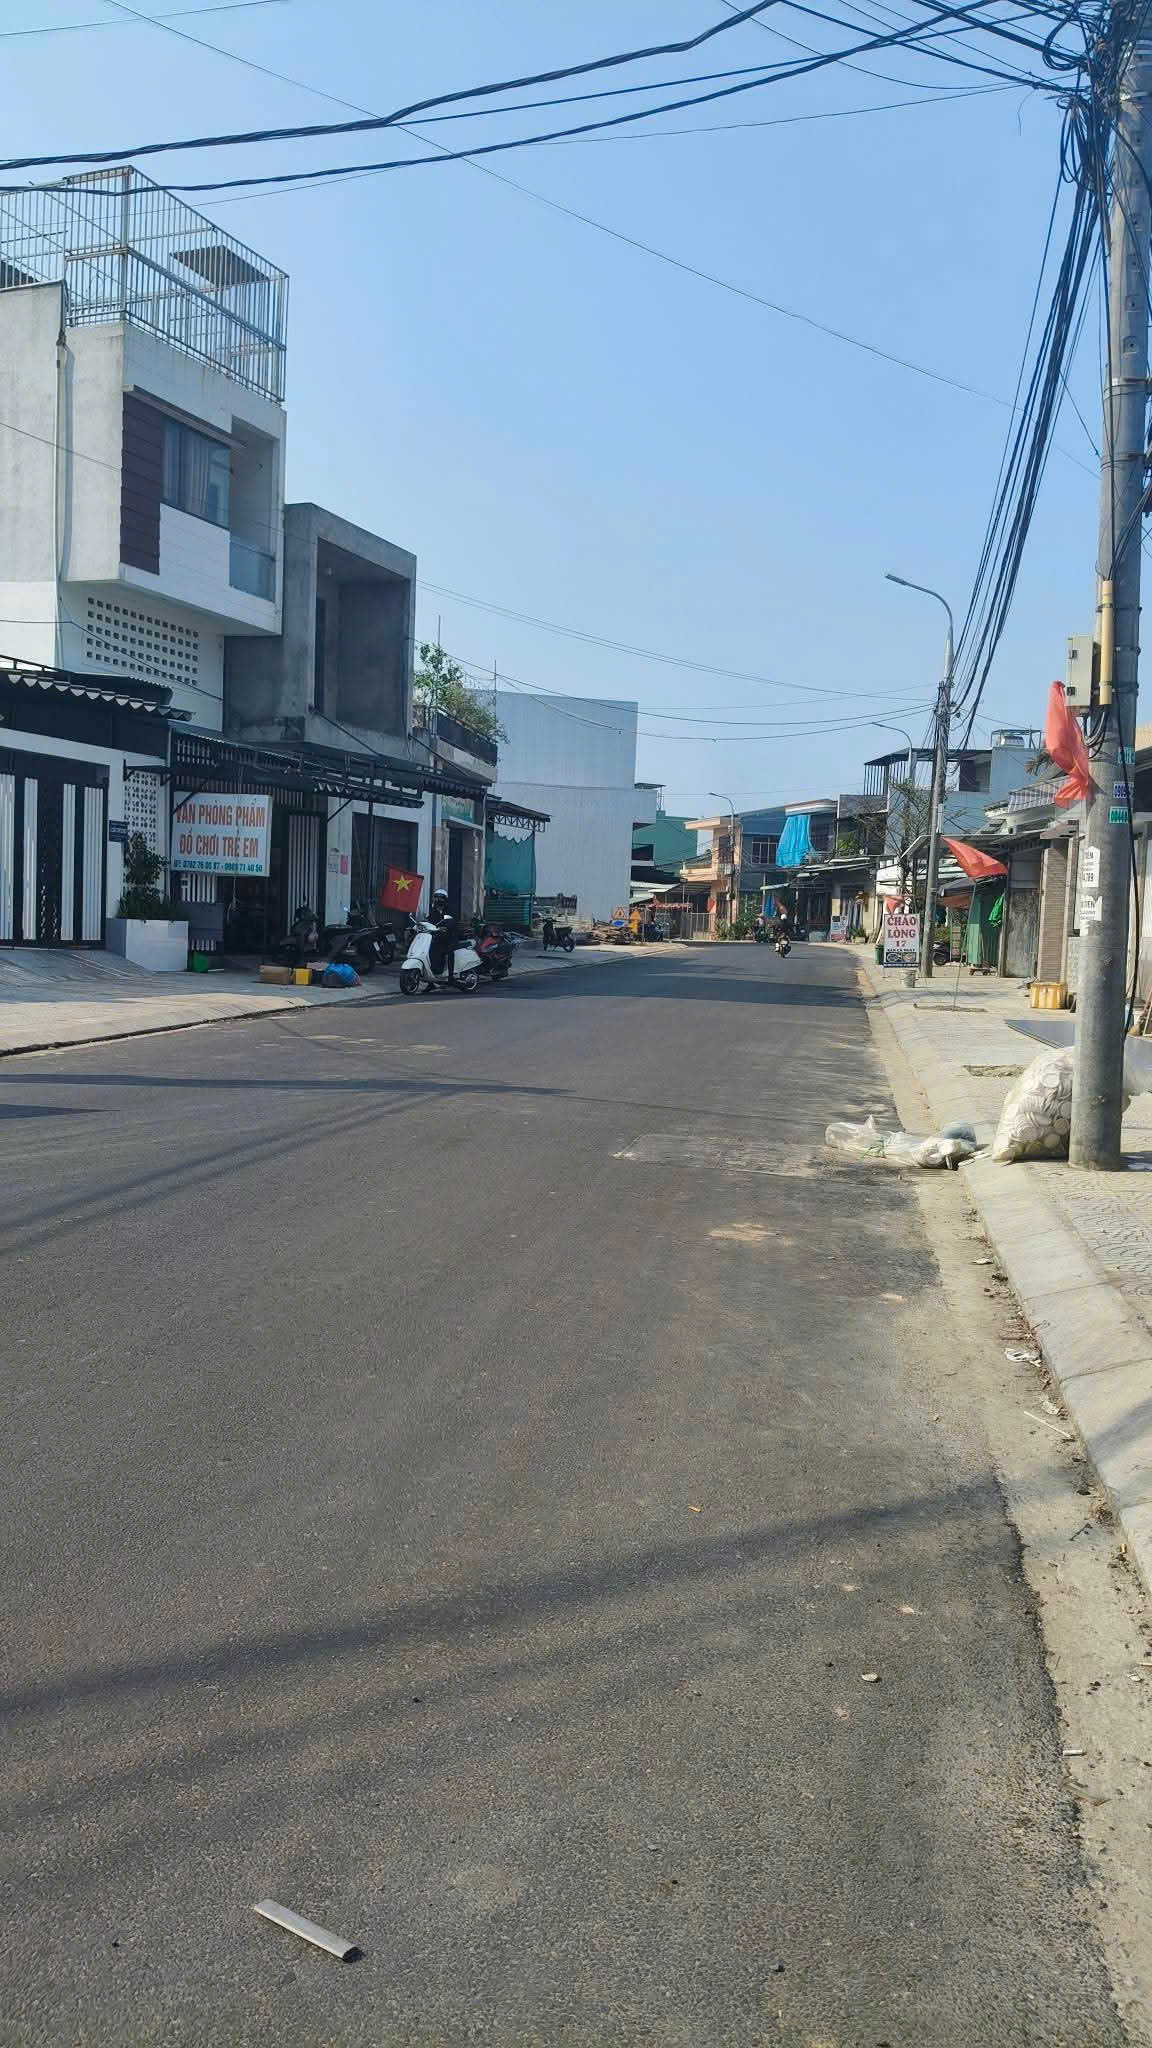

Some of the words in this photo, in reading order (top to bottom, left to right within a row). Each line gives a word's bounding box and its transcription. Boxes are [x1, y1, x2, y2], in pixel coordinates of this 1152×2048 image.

[198, 800, 232, 826] PHÒNG
[235, 798, 265, 828] PHẨM
[179, 827, 193, 855] ĐỒ
[196, 833, 219, 857] CHƠI
[243, 837, 259, 858] EM
[887, 914, 916, 926] CHÁO
[887, 927, 916, 938] LÒNG
